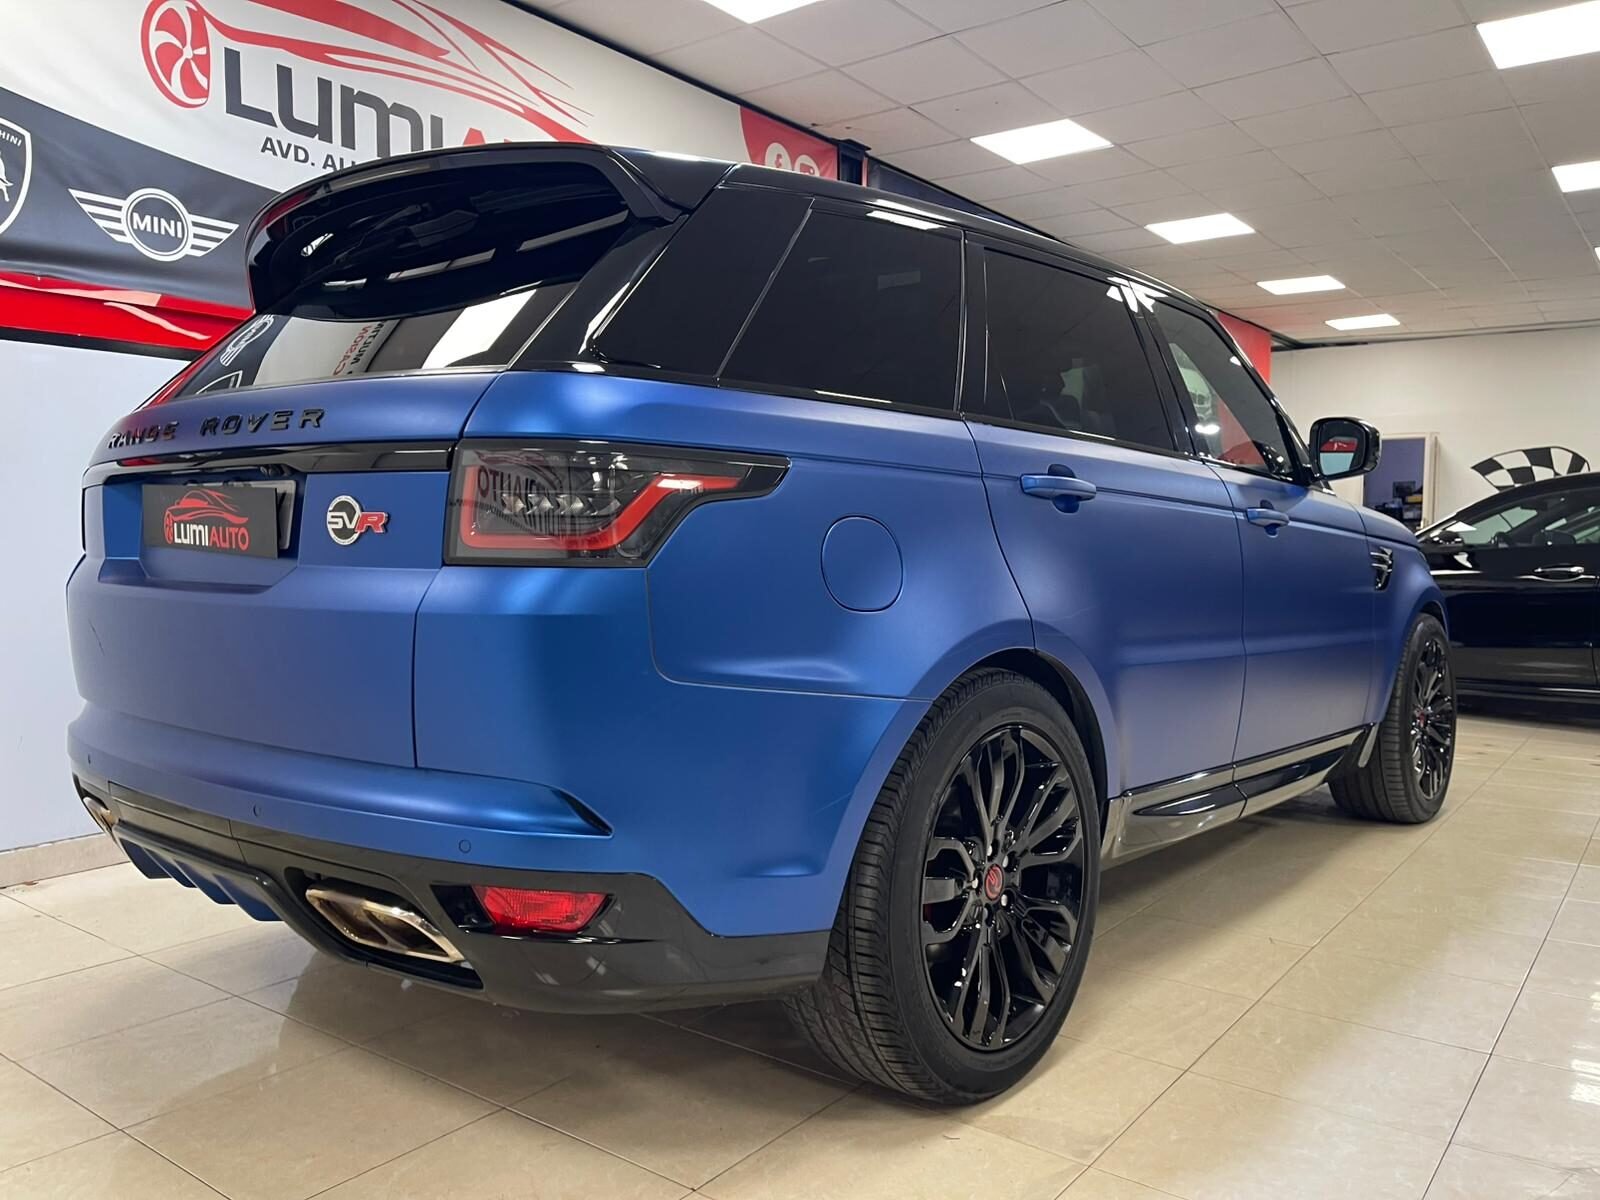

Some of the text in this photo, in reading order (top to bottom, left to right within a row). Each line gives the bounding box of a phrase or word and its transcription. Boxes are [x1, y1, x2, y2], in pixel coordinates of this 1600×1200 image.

[260, 136, 316, 167] AVD.
[132, 211, 183, 239] MINI
[107, 408, 325, 449] RANGE ROVER
[173, 521, 250, 551] LUMIAUTO
[327, 511, 388, 533] SVR
